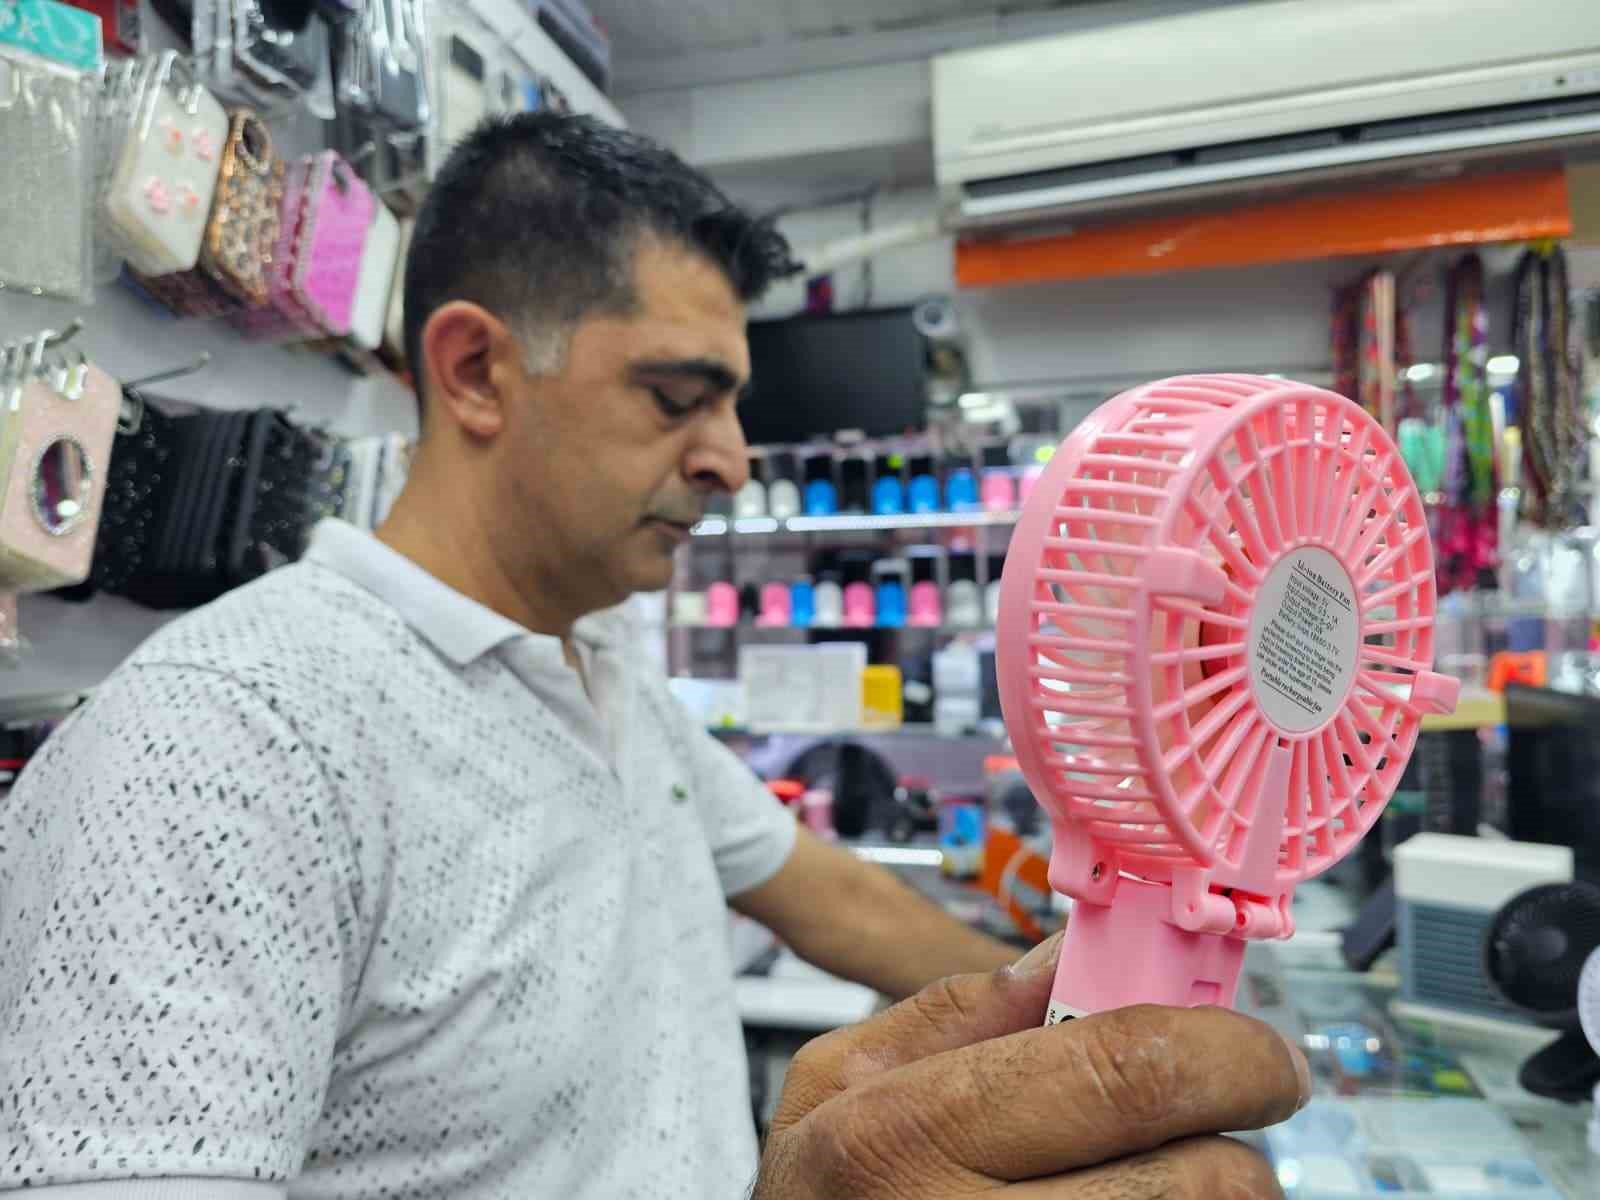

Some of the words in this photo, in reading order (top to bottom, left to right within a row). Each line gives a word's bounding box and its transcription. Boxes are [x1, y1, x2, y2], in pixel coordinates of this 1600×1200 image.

[1297, 559, 1316, 580] Li-ion
[1316, 574, 1338, 598] Battery
[1338, 592, 1350, 607] Fan
[1260, 666, 1281, 686] Portable
[1312, 700, 1321, 713] fan
